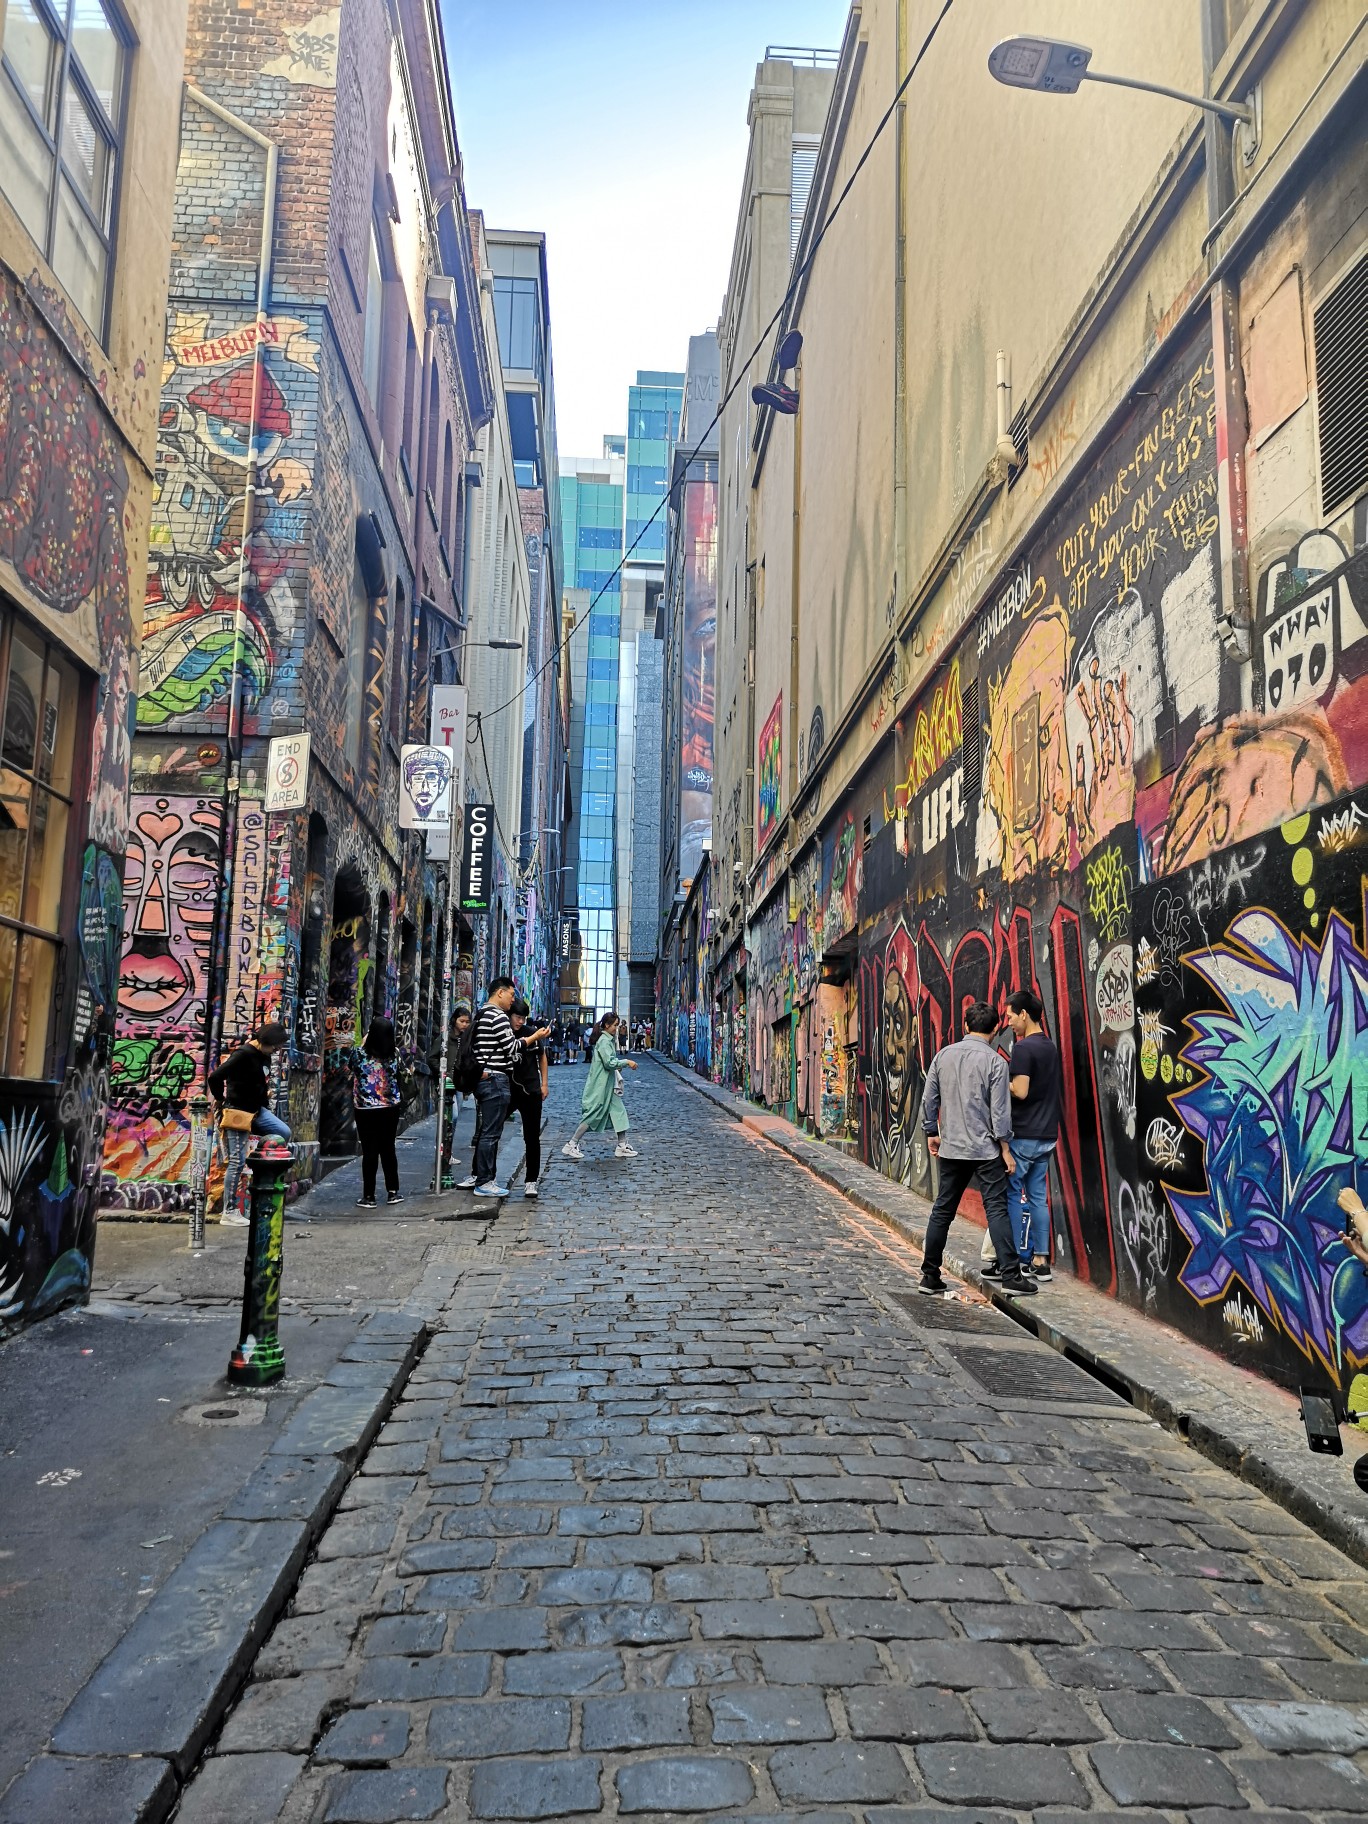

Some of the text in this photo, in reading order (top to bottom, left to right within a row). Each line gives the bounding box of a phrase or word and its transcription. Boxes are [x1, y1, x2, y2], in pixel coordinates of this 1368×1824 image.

[439, 707, 460, 721] Bar
[277, 742, 301, 757] END
[271, 789, 299, 804] AREA
[468, 806, 488, 897] COFFEE
